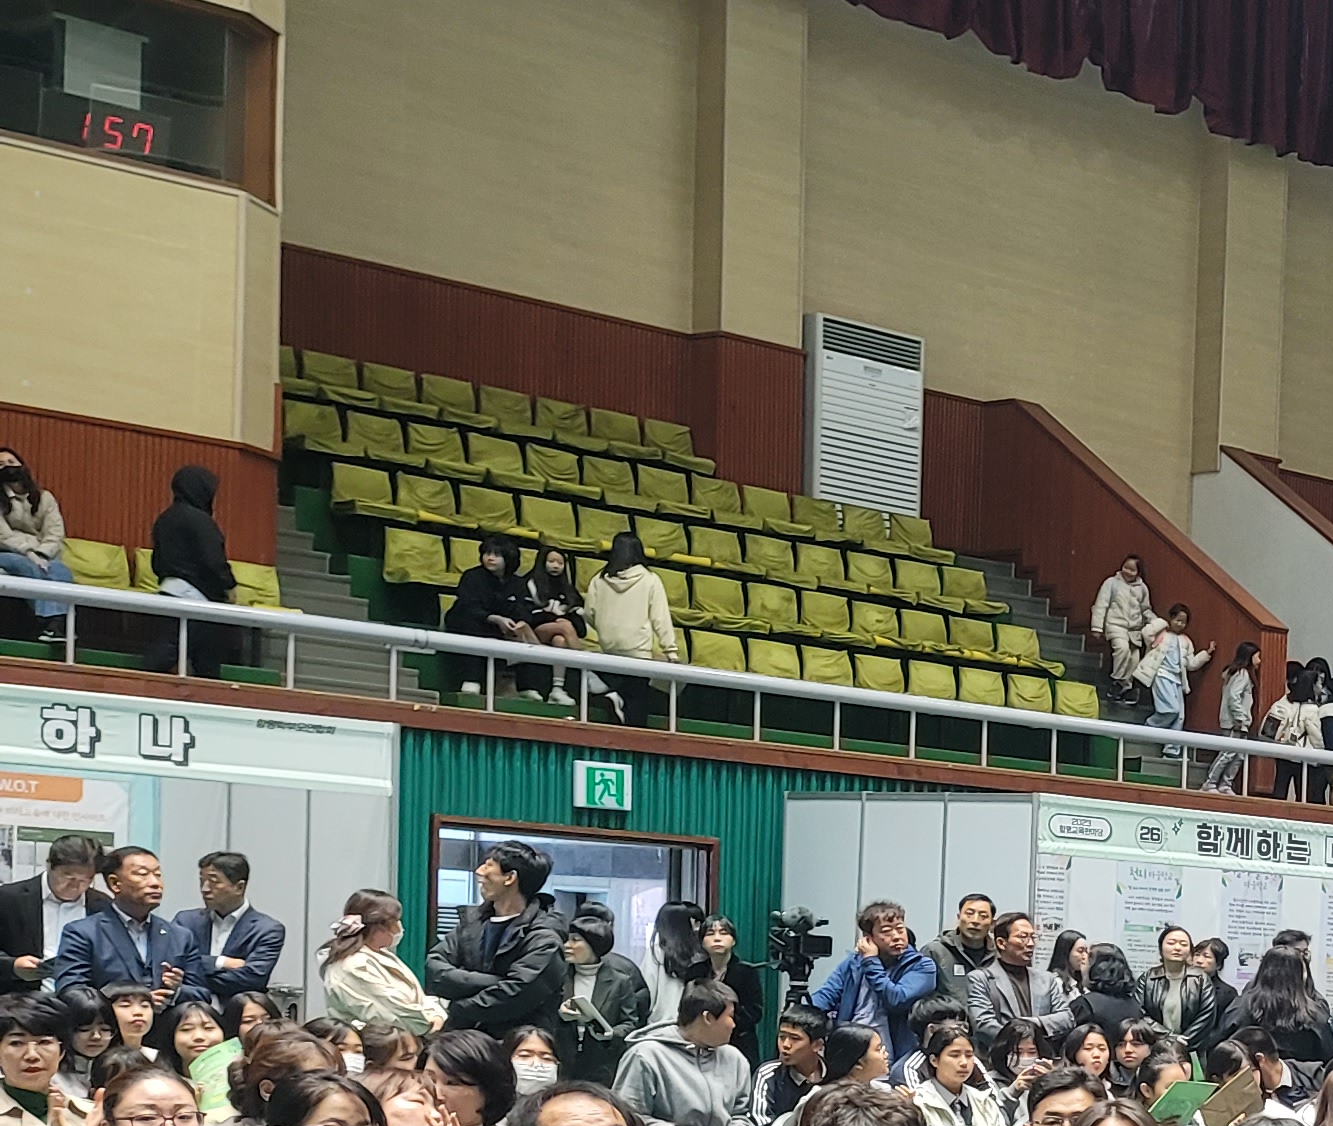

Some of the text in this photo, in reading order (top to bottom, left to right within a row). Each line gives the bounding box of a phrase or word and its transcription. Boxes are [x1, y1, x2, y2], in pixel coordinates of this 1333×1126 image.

[40, 703, 195, 766] 하 나
[1138, 825, 1162, 843] 26
[1196, 823, 1311, 865] 함께하는
